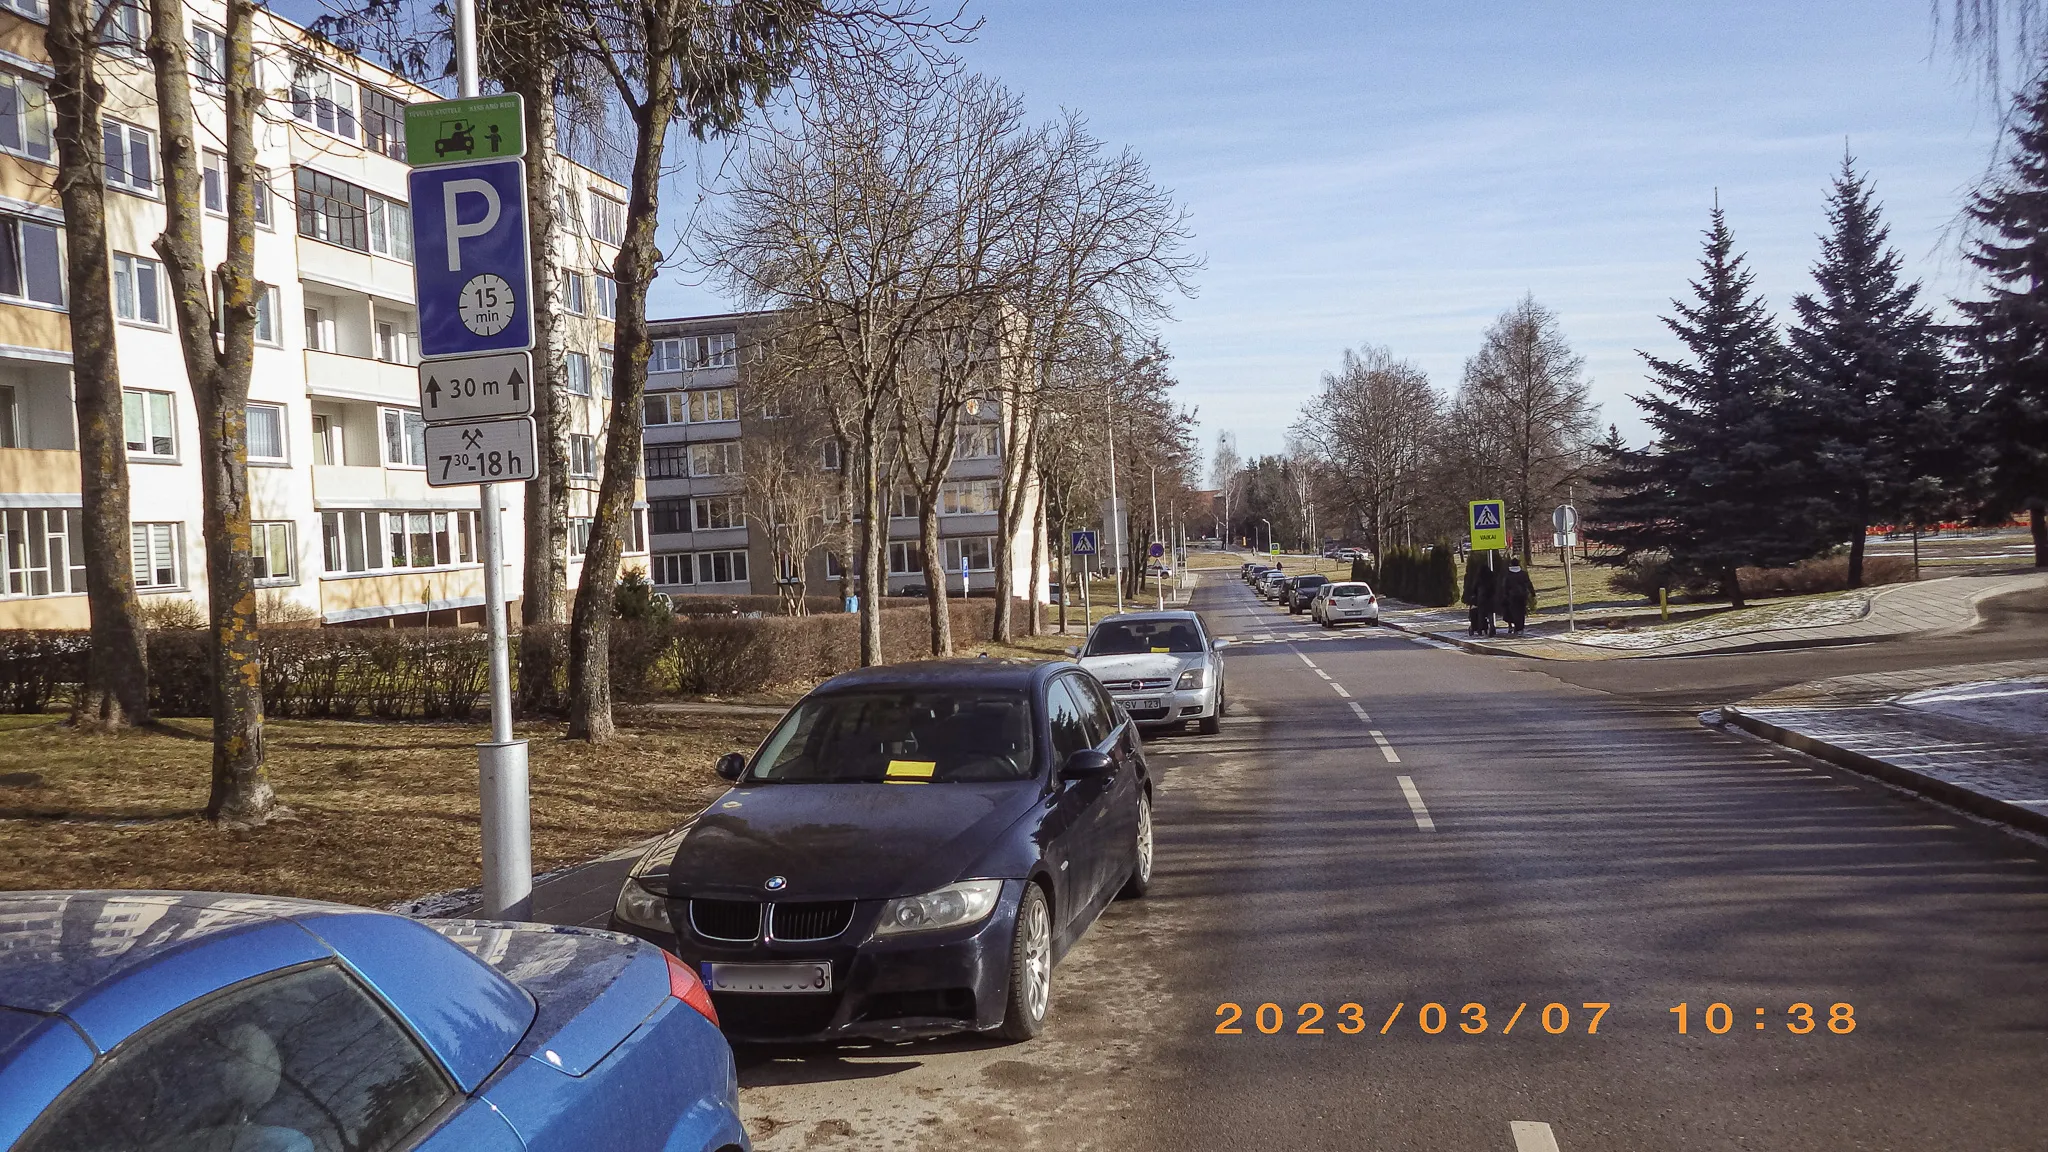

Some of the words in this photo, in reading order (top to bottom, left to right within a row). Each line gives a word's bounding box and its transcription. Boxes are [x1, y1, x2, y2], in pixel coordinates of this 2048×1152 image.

[443, 178, 501, 272] P
[474, 287, 498, 309] 15
[475, 310, 499, 324] min
[450, 377, 476, 399] 30
[482, 380, 500, 396] m
[508, 450, 522, 475] h
[1143, 700, 1159, 708] 123
